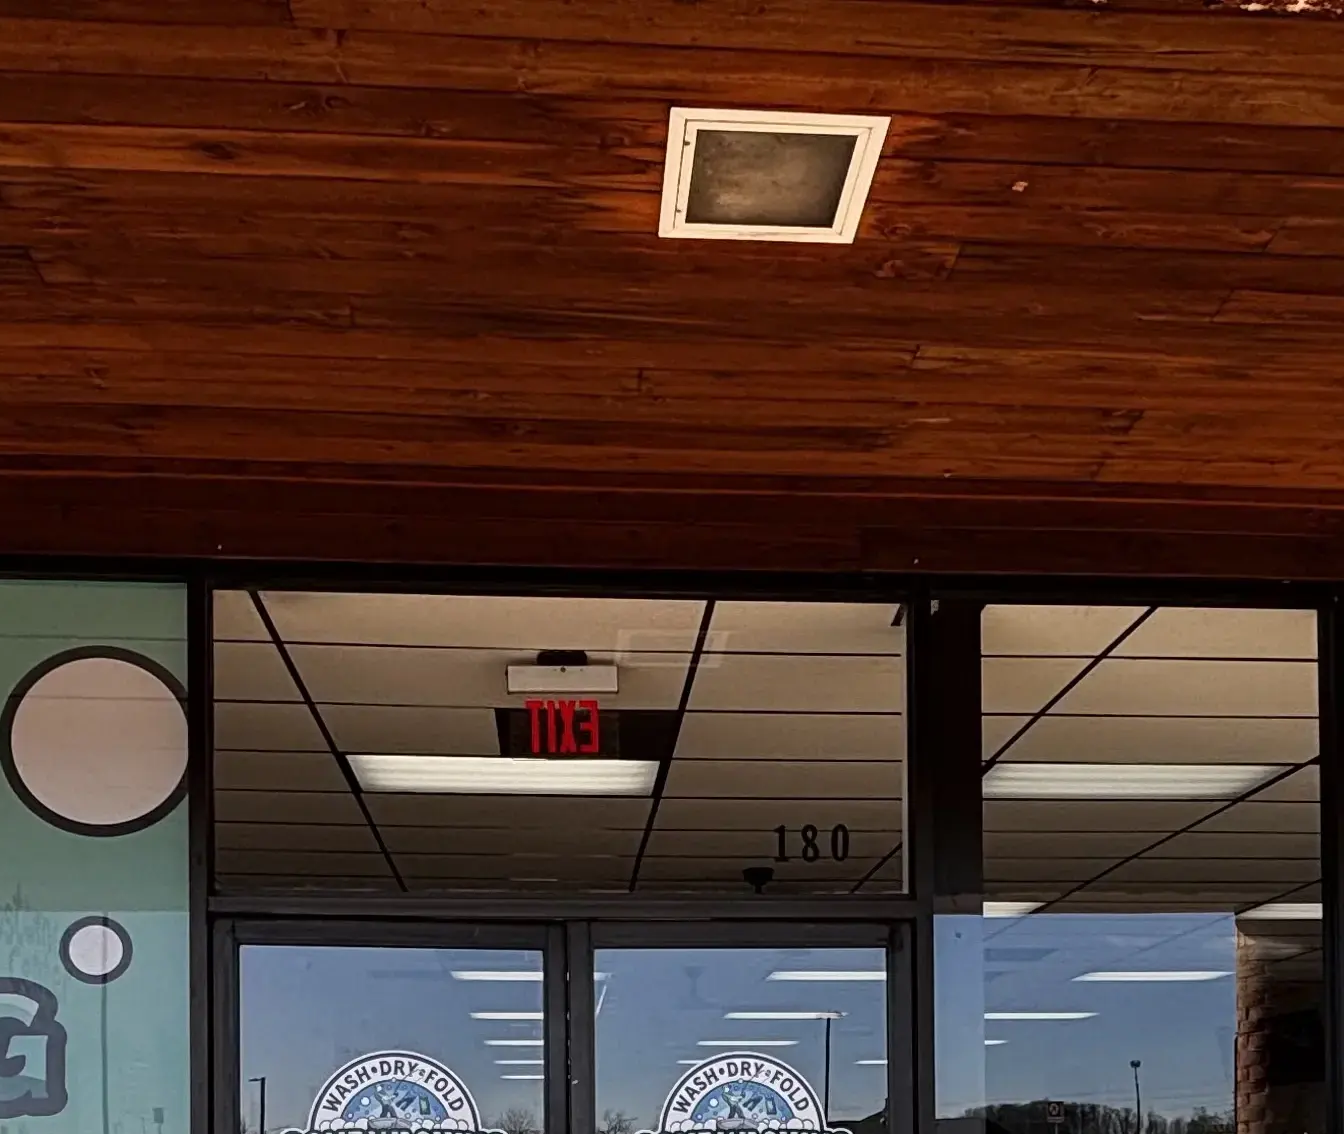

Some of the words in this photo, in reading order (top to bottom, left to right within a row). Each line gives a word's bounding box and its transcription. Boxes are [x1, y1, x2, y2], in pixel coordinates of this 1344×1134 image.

[772, 823, 850, 863] 180
[323, 1066, 372, 1113] WASH
[381, 1059, 419, 1076] DRY
[426, 1070, 464, 1112] FOLD
[673, 1069, 720, 1114] WASH
[727, 1061, 764, 1077] DRY
[773, 1072, 810, 1112] FOLD
